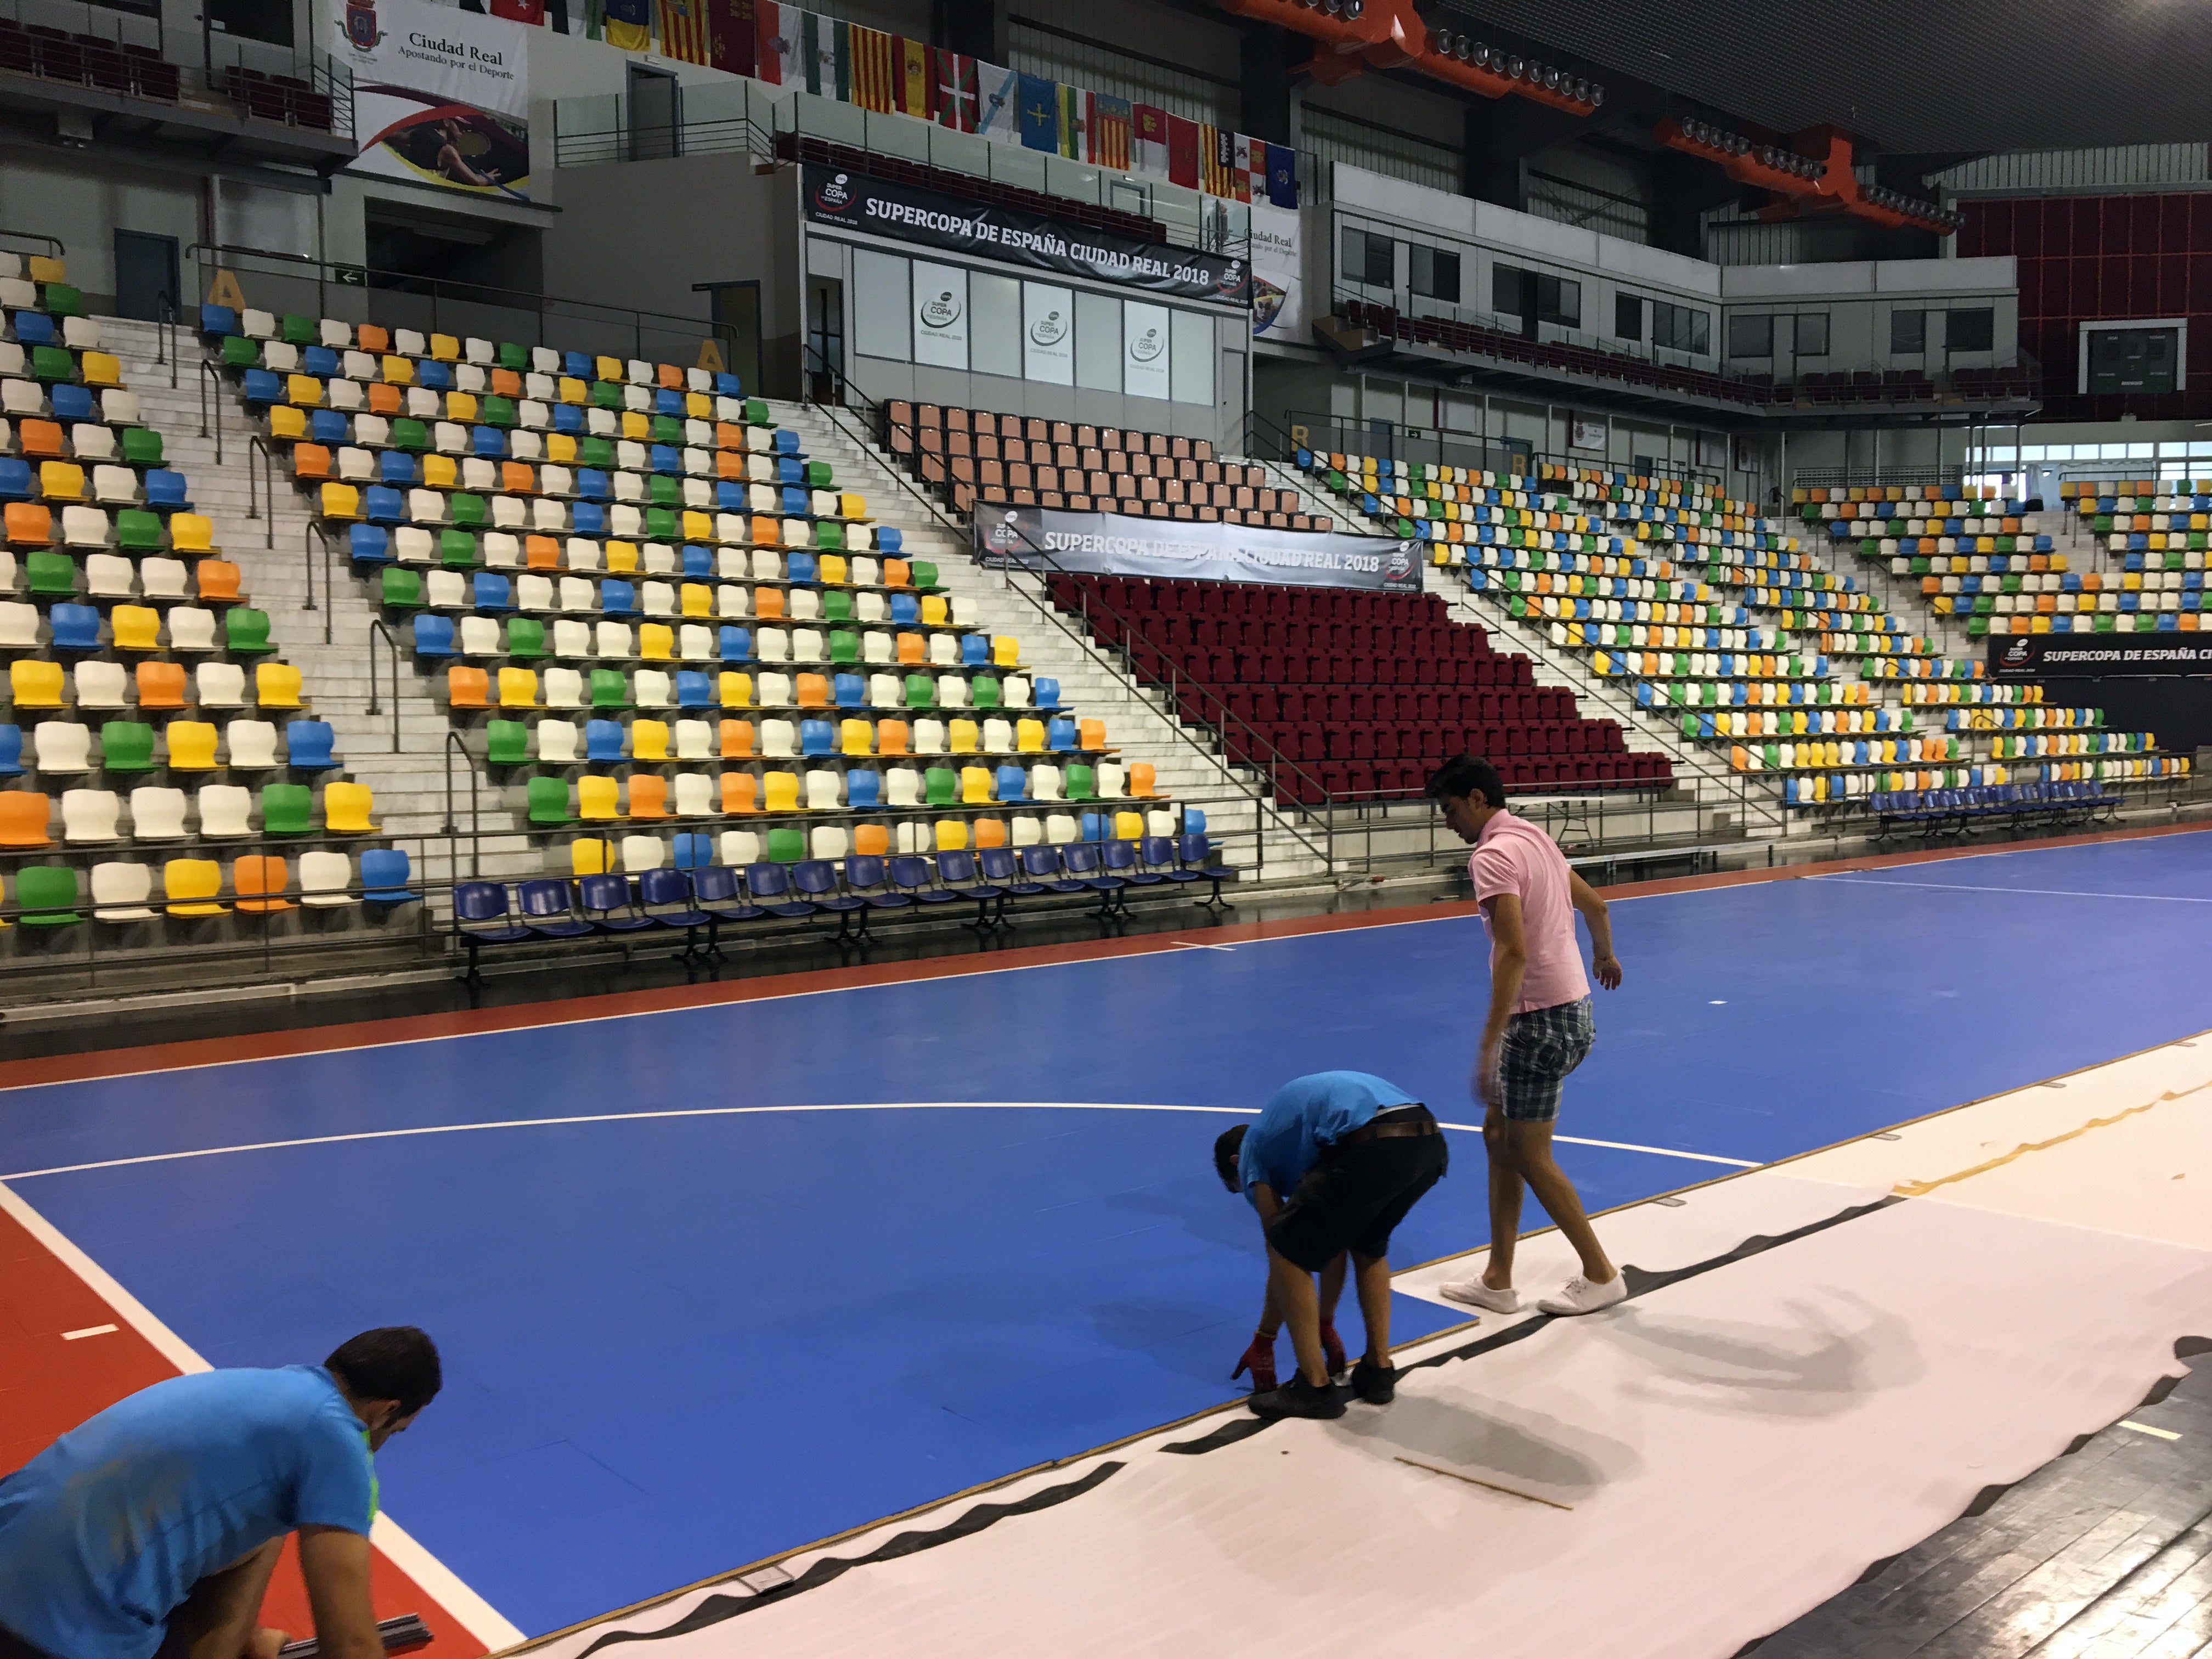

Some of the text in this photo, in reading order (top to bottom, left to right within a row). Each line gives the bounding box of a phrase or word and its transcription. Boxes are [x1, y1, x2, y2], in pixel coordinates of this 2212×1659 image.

[409, 32, 503, 65] Ciudad Real
[398, 46, 514, 80] Apostando por el Deporte
[825, 188, 848, 200] COPA
[866, 198, 1209, 285] SUPERCOPA DE ESPAÑA CIUDAD REAL 2018
[1274, 235, 1291, 247] Real
[1224, 273, 1240, 282] COPA
[207, 269, 246, 313] A
[930, 306, 952, 316] COPA
[1039, 325, 1059, 335] COPA
[1138, 342, 1156, 351] COPA
[696, 340, 725, 372] A
[1045, 532, 1149, 556] SUPERCOPA
[1304, 551, 1341, 569] REAL
[1344, 554, 1379, 572] 2018
[1391, 557, 1409, 566] COPA
[2043, 650, 2121, 662] SUPERCOPA
[2123, 650, 2142, 661] DE
[2143, 647, 2197, 661] ESPAÑA
